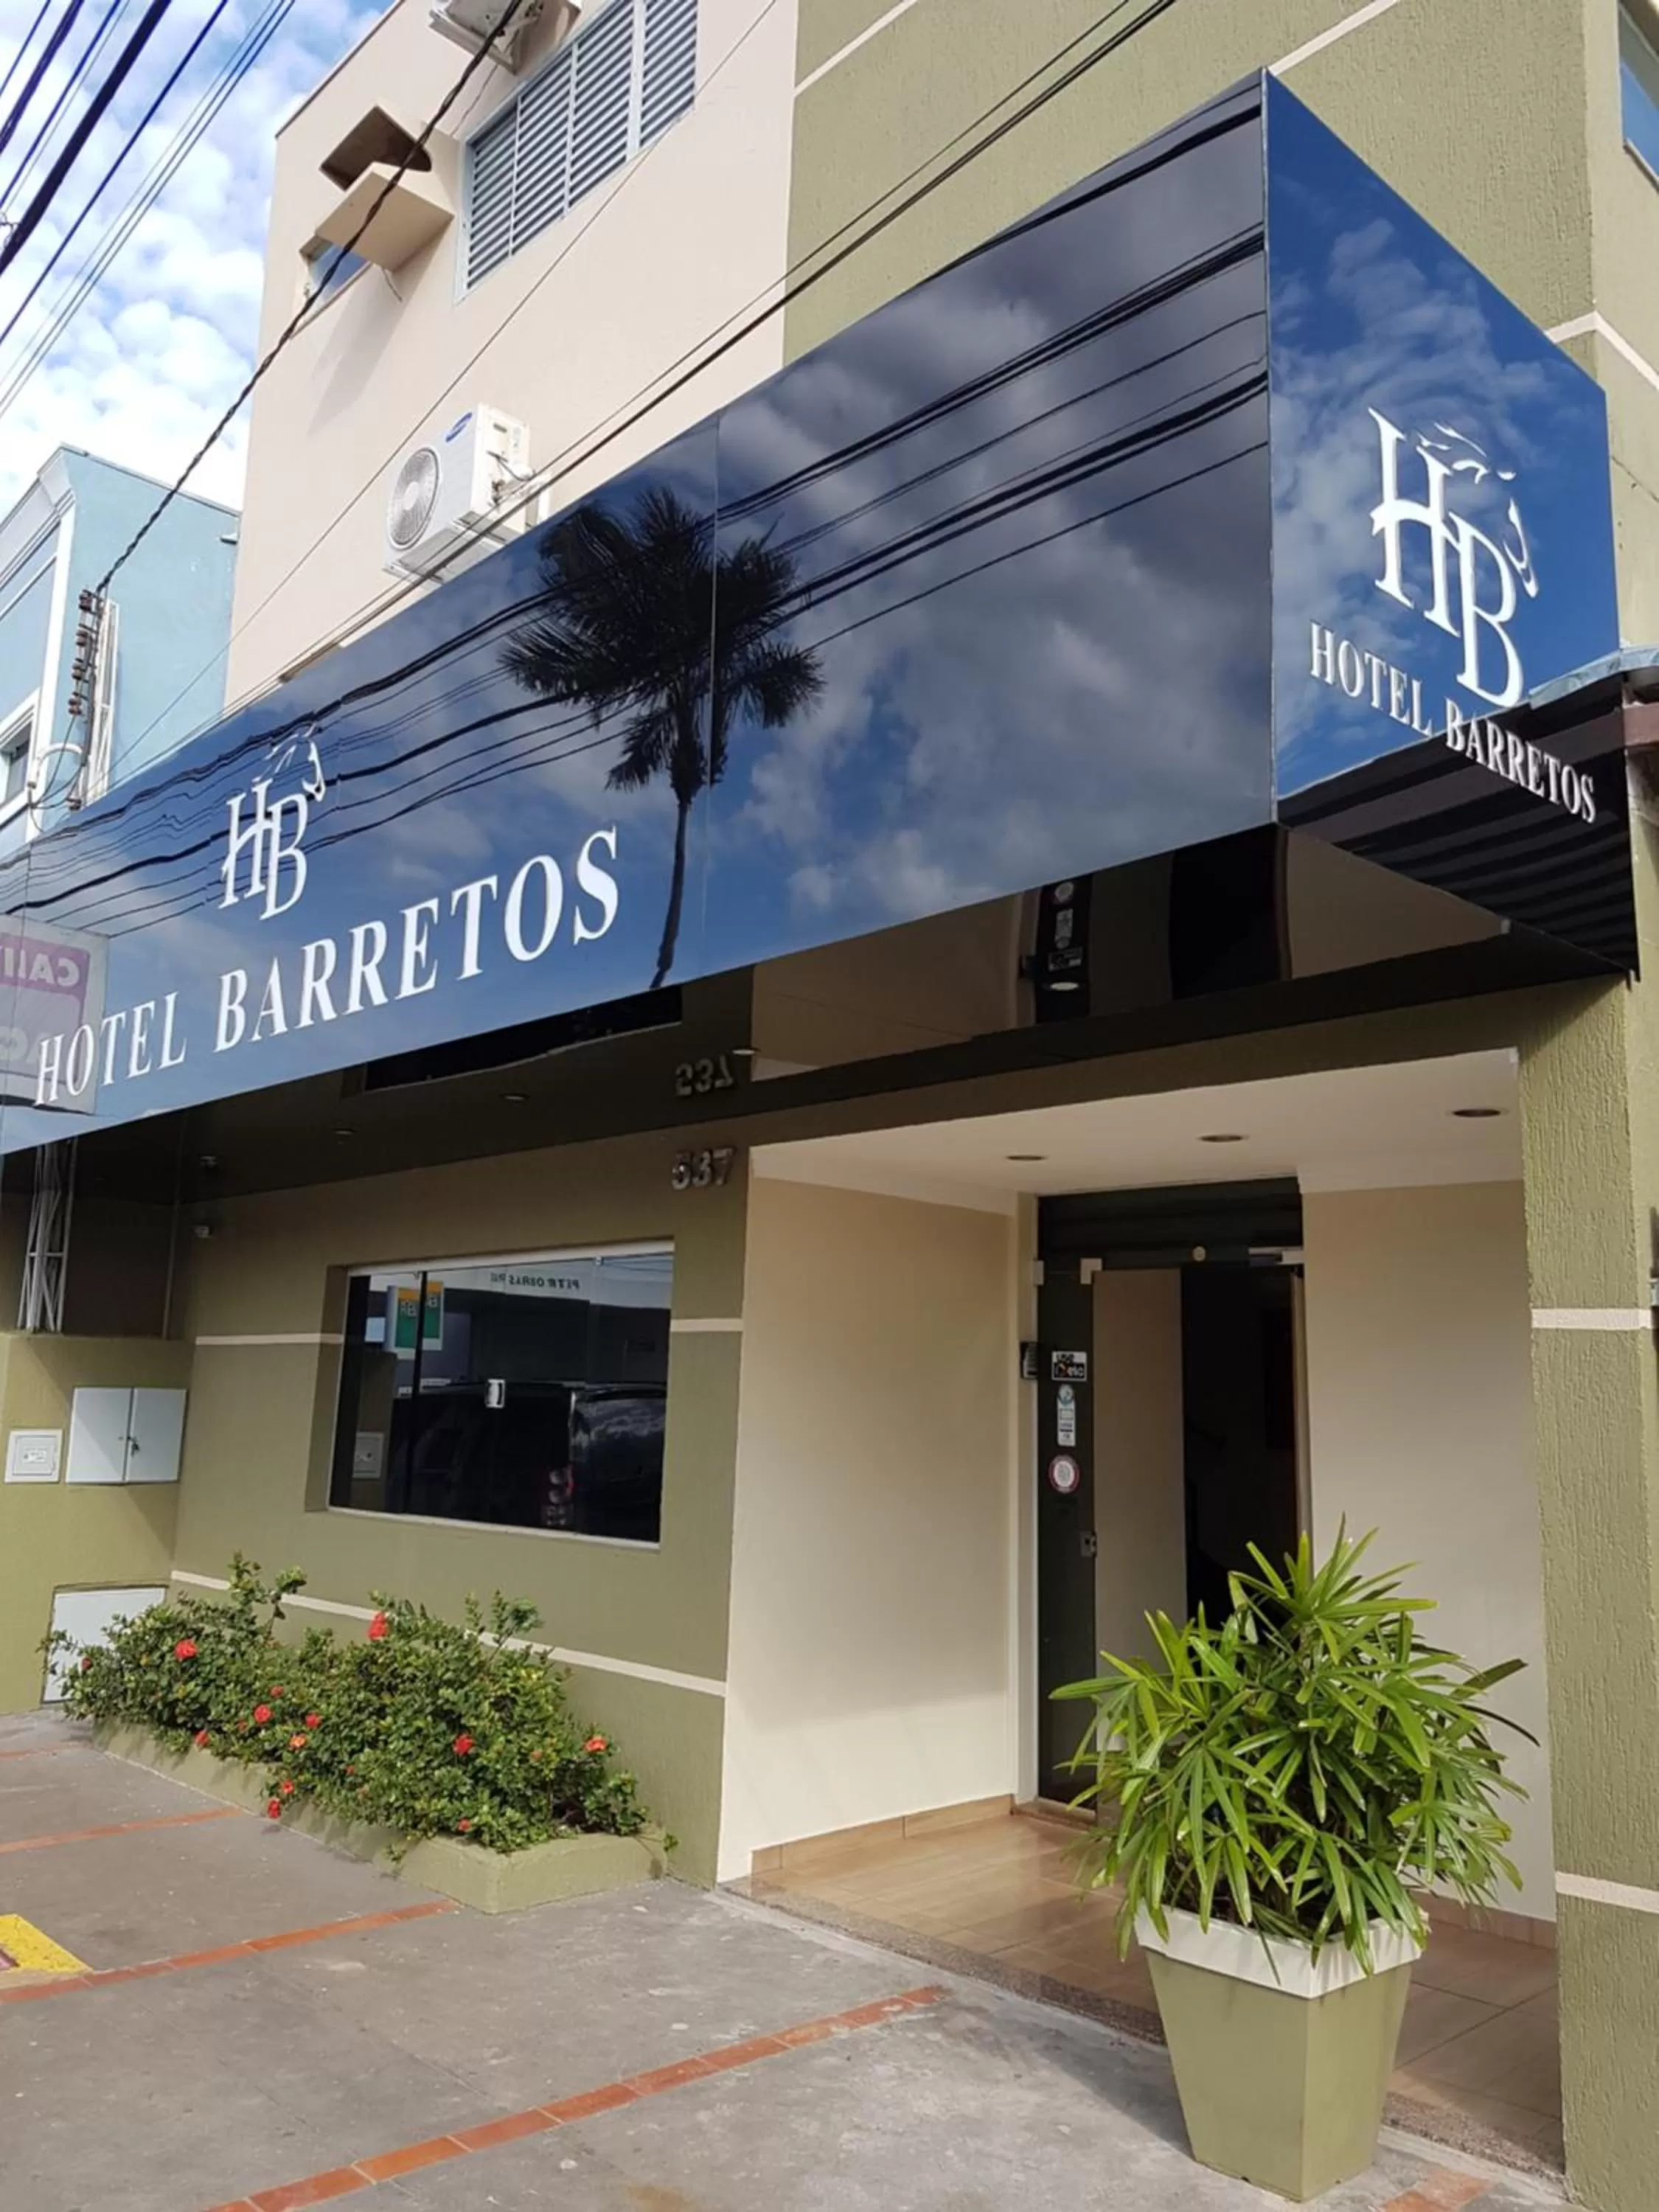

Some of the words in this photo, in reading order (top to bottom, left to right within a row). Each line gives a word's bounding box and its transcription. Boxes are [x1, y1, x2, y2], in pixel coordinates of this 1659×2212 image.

[1308, 619, 1433, 737] HOTEL
[1444, 695, 1597, 825] BARRETOS
[34, 991, 187, 1107] HOTEL
[212, 824, 621, 1054] BARRETOS
